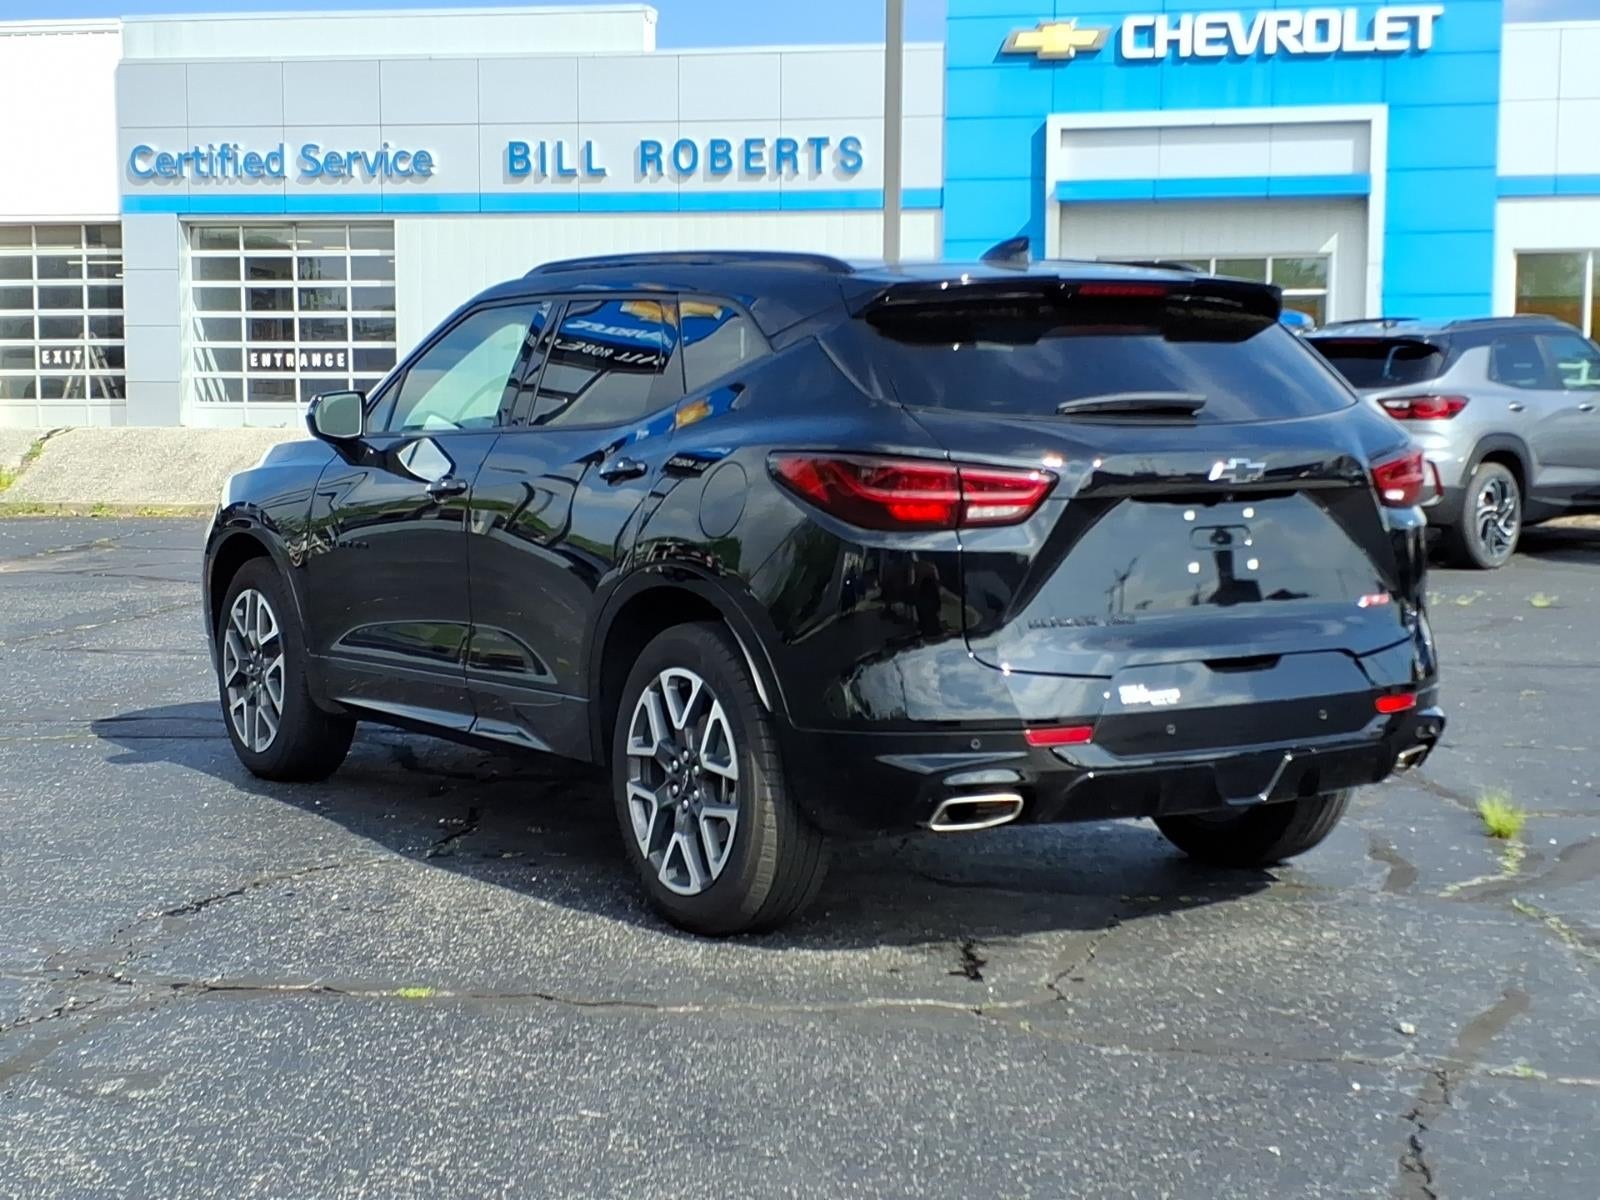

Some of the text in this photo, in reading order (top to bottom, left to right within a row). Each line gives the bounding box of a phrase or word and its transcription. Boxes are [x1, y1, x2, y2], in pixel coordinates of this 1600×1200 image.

[1121, 5, 1444, 60] CHEVROLET
[129, 141, 435, 180] Certified Service
[506, 135, 864, 177] BILL ROBERTS
[41, 350, 83, 364] EXIT
[250, 352, 346, 368] ENTRANCE
